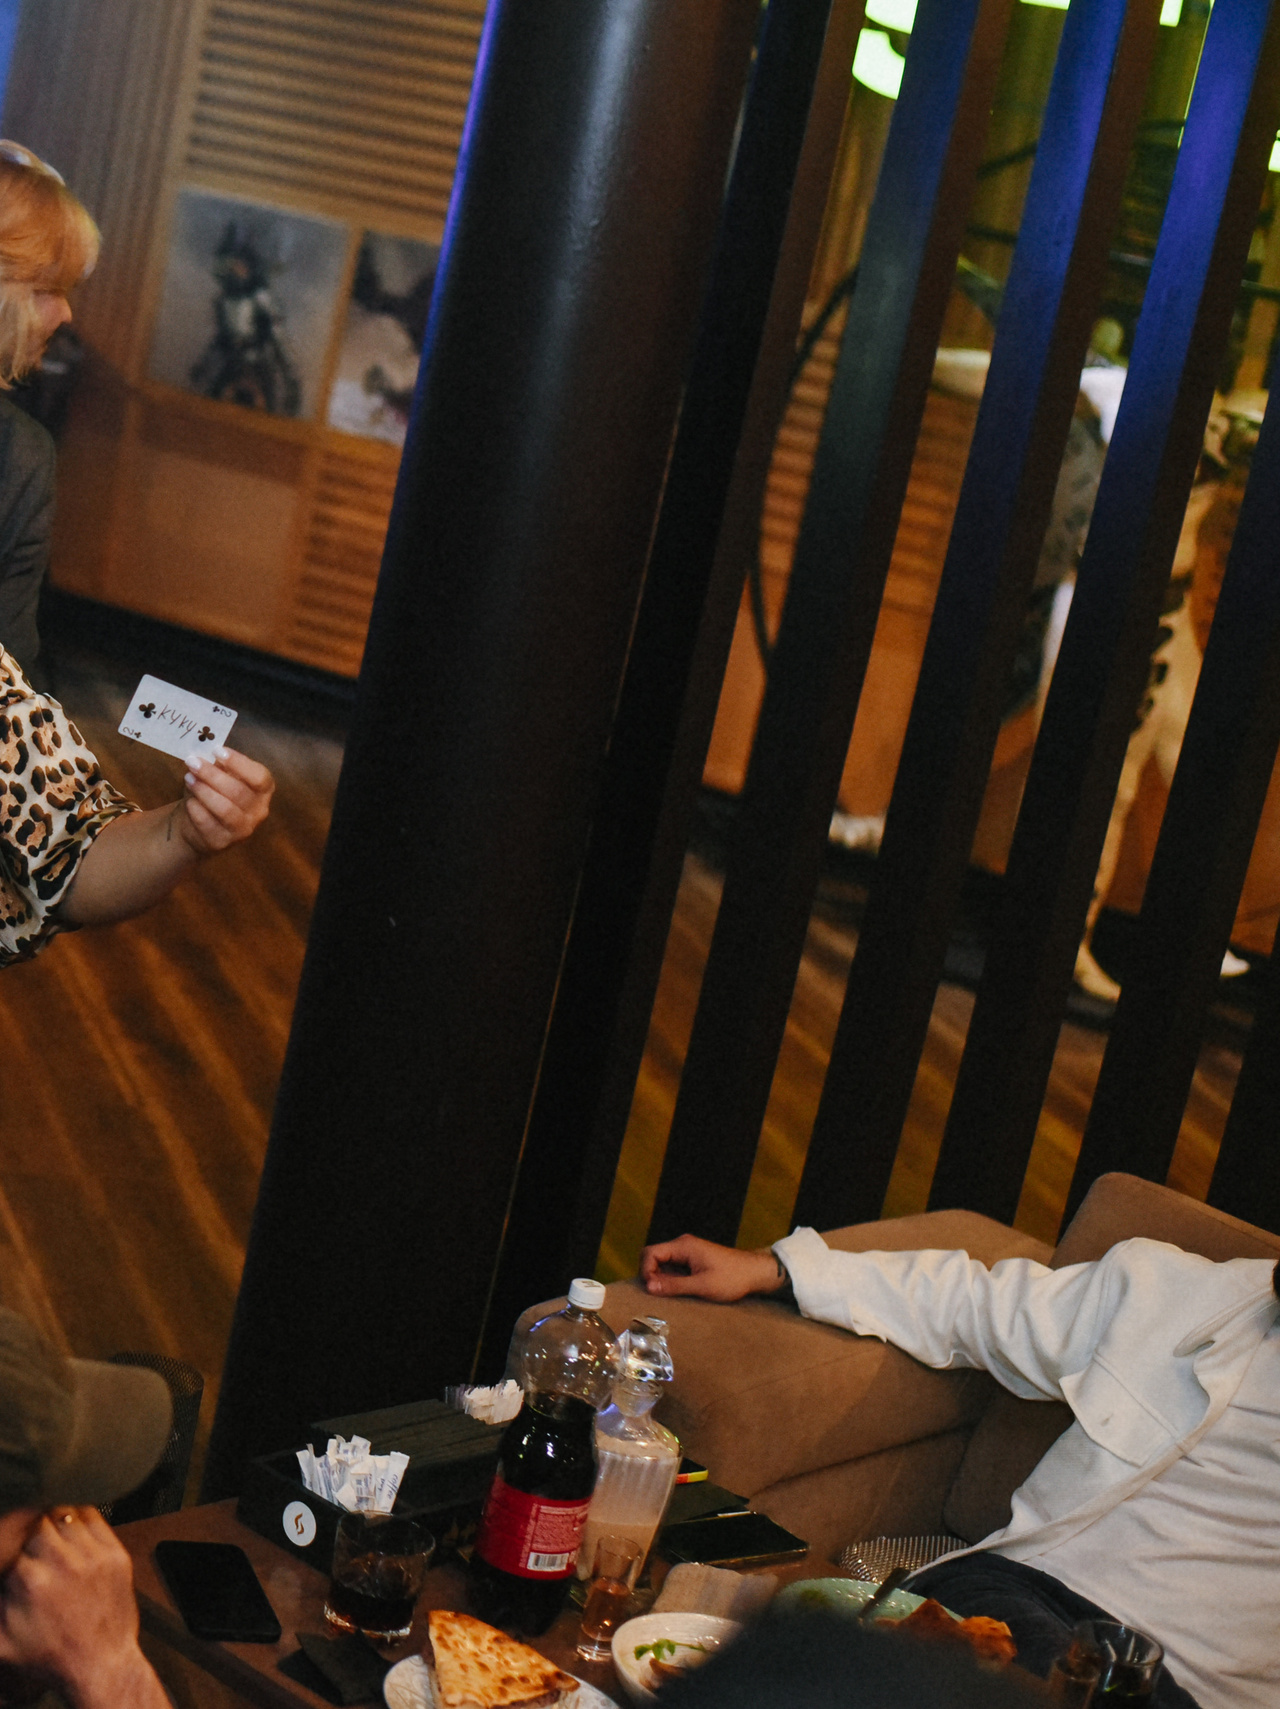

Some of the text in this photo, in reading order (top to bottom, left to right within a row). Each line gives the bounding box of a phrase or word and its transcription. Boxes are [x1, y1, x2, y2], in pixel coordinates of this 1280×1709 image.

[220, 708, 232, 718] 2
[122, 726, 135, 736] 2
[385, 1473, 399, 1500] coffee
